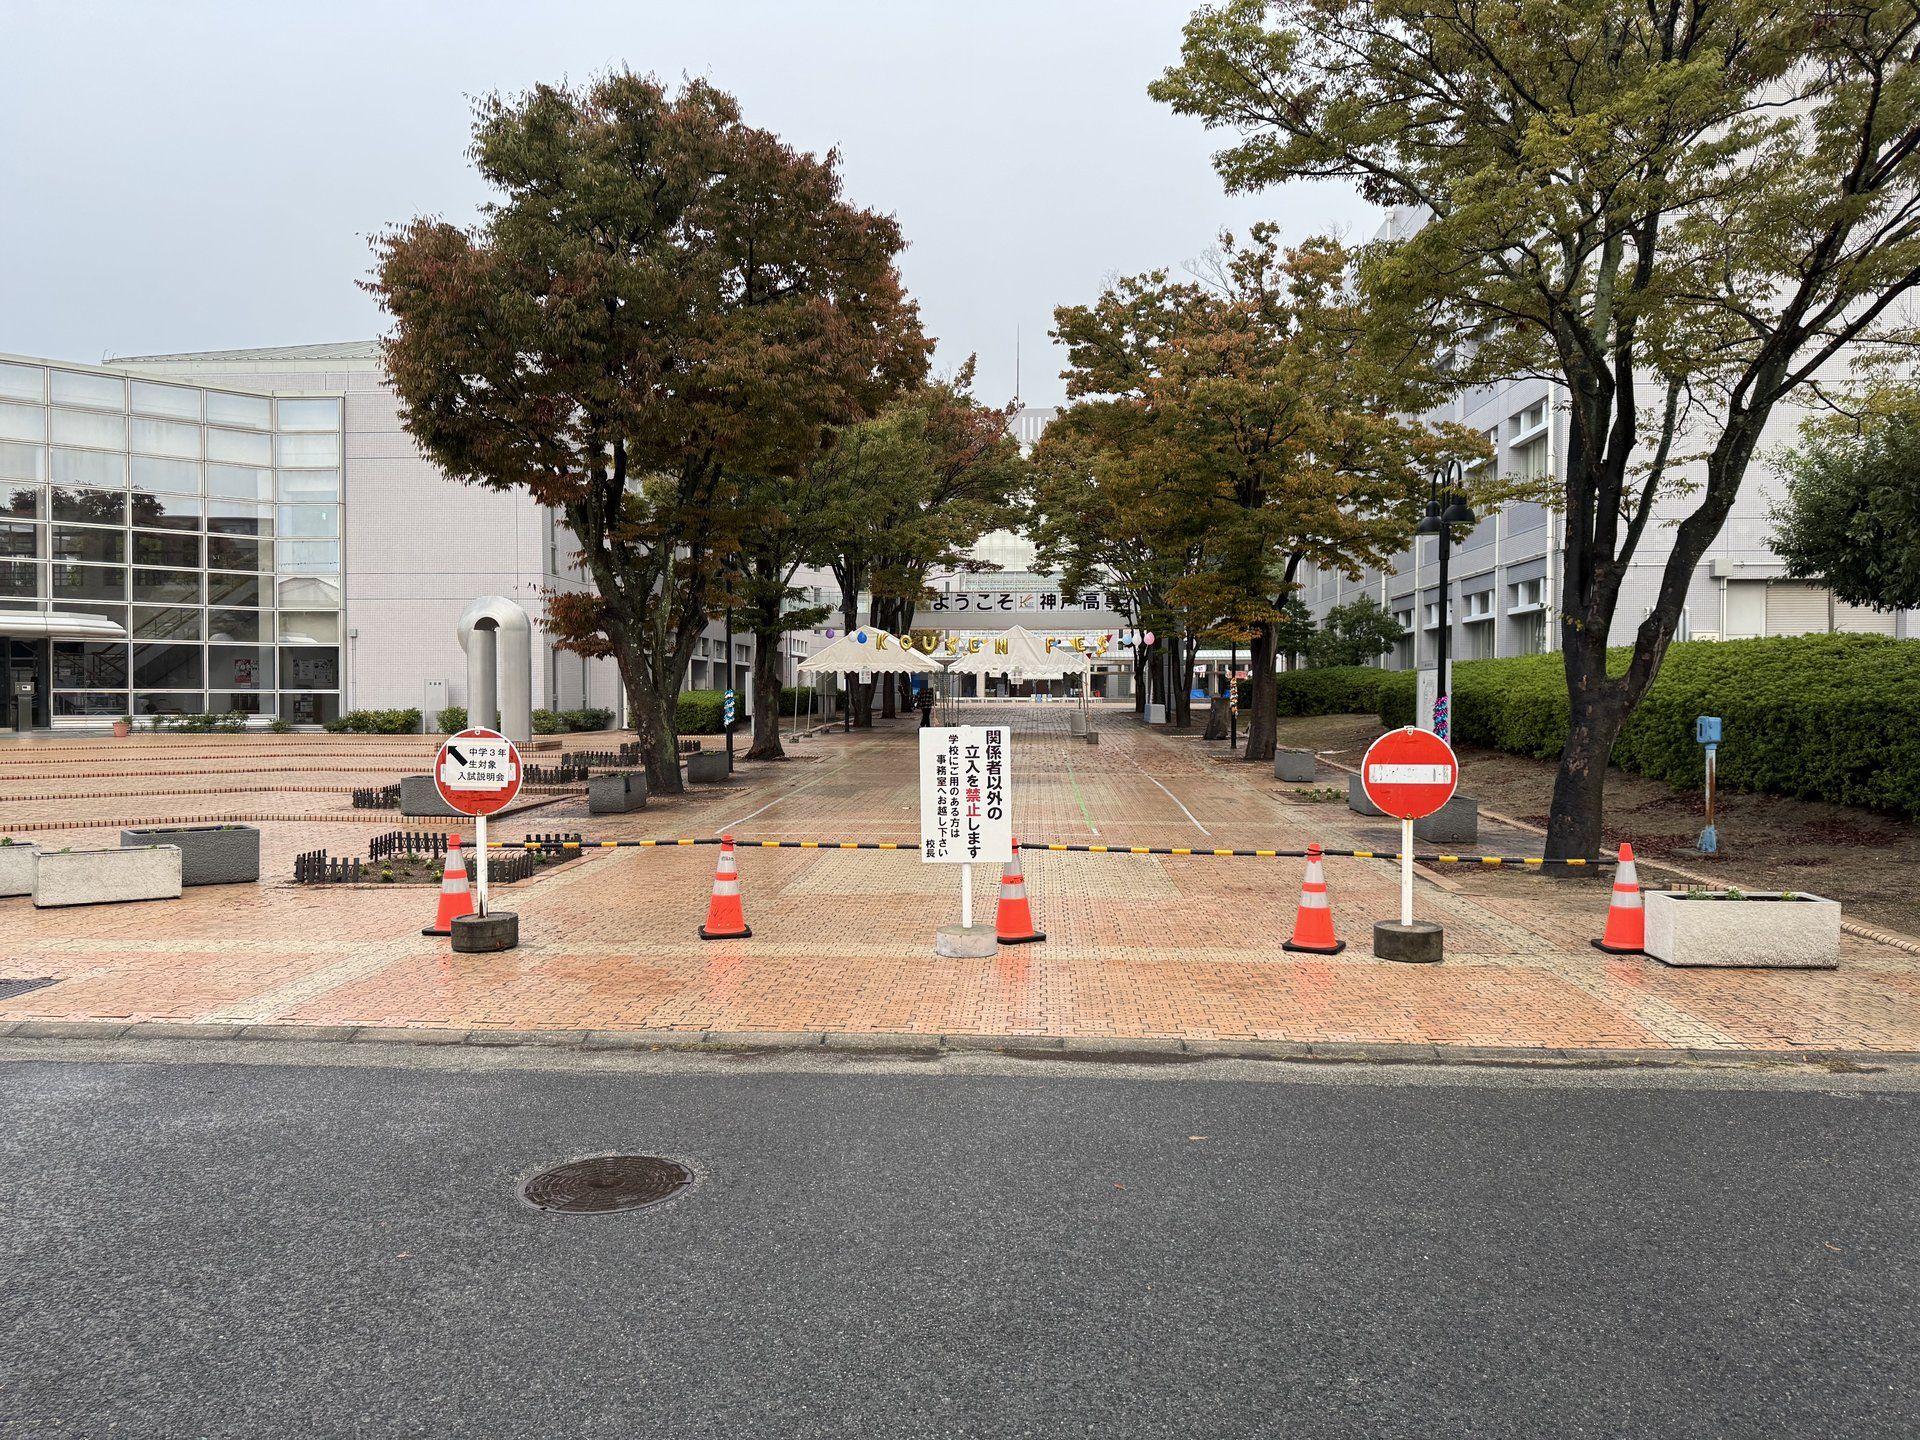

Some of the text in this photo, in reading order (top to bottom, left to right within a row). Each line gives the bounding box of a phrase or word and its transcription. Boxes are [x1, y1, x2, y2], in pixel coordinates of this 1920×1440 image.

[933, 593, 1014, 610] ようこそ
[876, 633, 1008, 656] KOUSEN
[469, 748, 507, 757] 中学3年
[468, 760, 497, 769] 生対象
[985, 730, 1003, 820] 関係者以外の
[457, 772, 505, 782] 入試説明会
[948, 734, 960, 838] 学校にご用のある方は
[936, 754, 948, 857] 事務室へお越し下さい
[964, 745, 981, 859] 立入を禁止します
[926, 839, 935, 858] 校長
